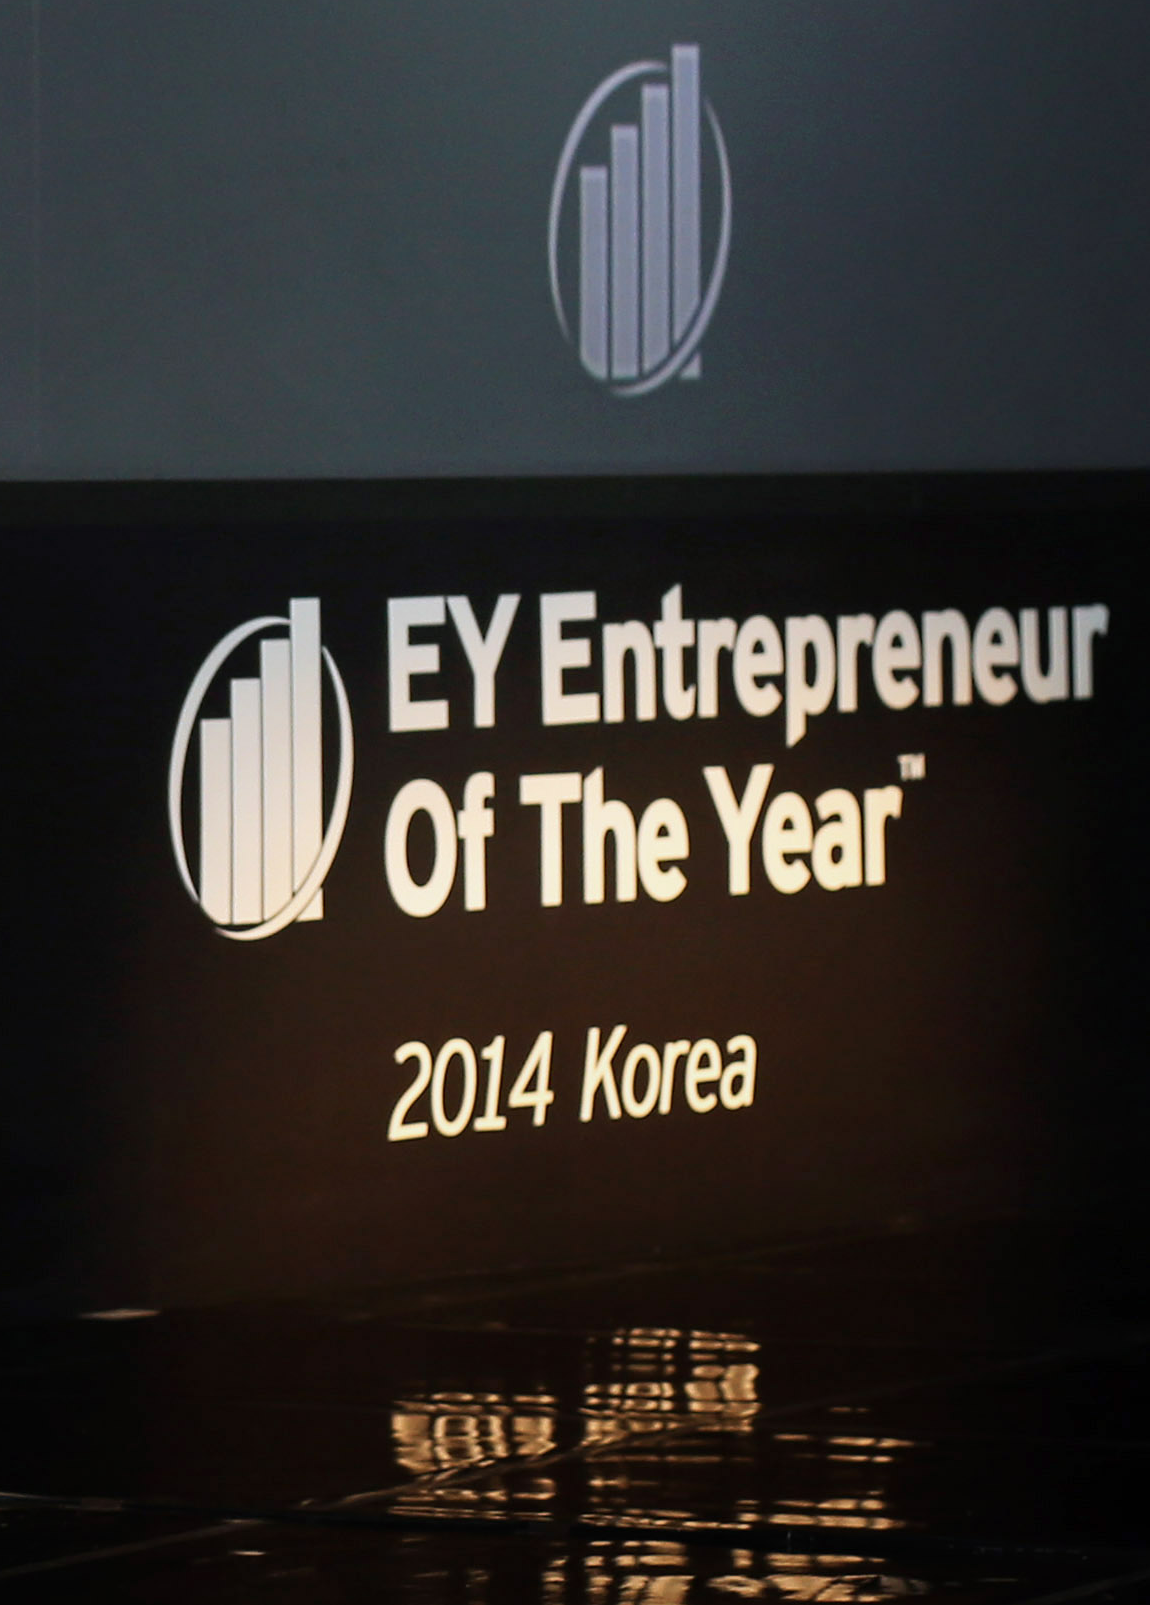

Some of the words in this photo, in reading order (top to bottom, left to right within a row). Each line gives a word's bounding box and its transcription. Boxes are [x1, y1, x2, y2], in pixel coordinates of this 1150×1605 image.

[386, 593, 521, 733] EY
[539, 583, 1108, 748] Entrepreneur
[384, 771, 496, 918] Of
[519, 766, 690, 908] The
[387, 1030, 555, 1142] 2014
[579, 1024, 759, 1123] Korea
